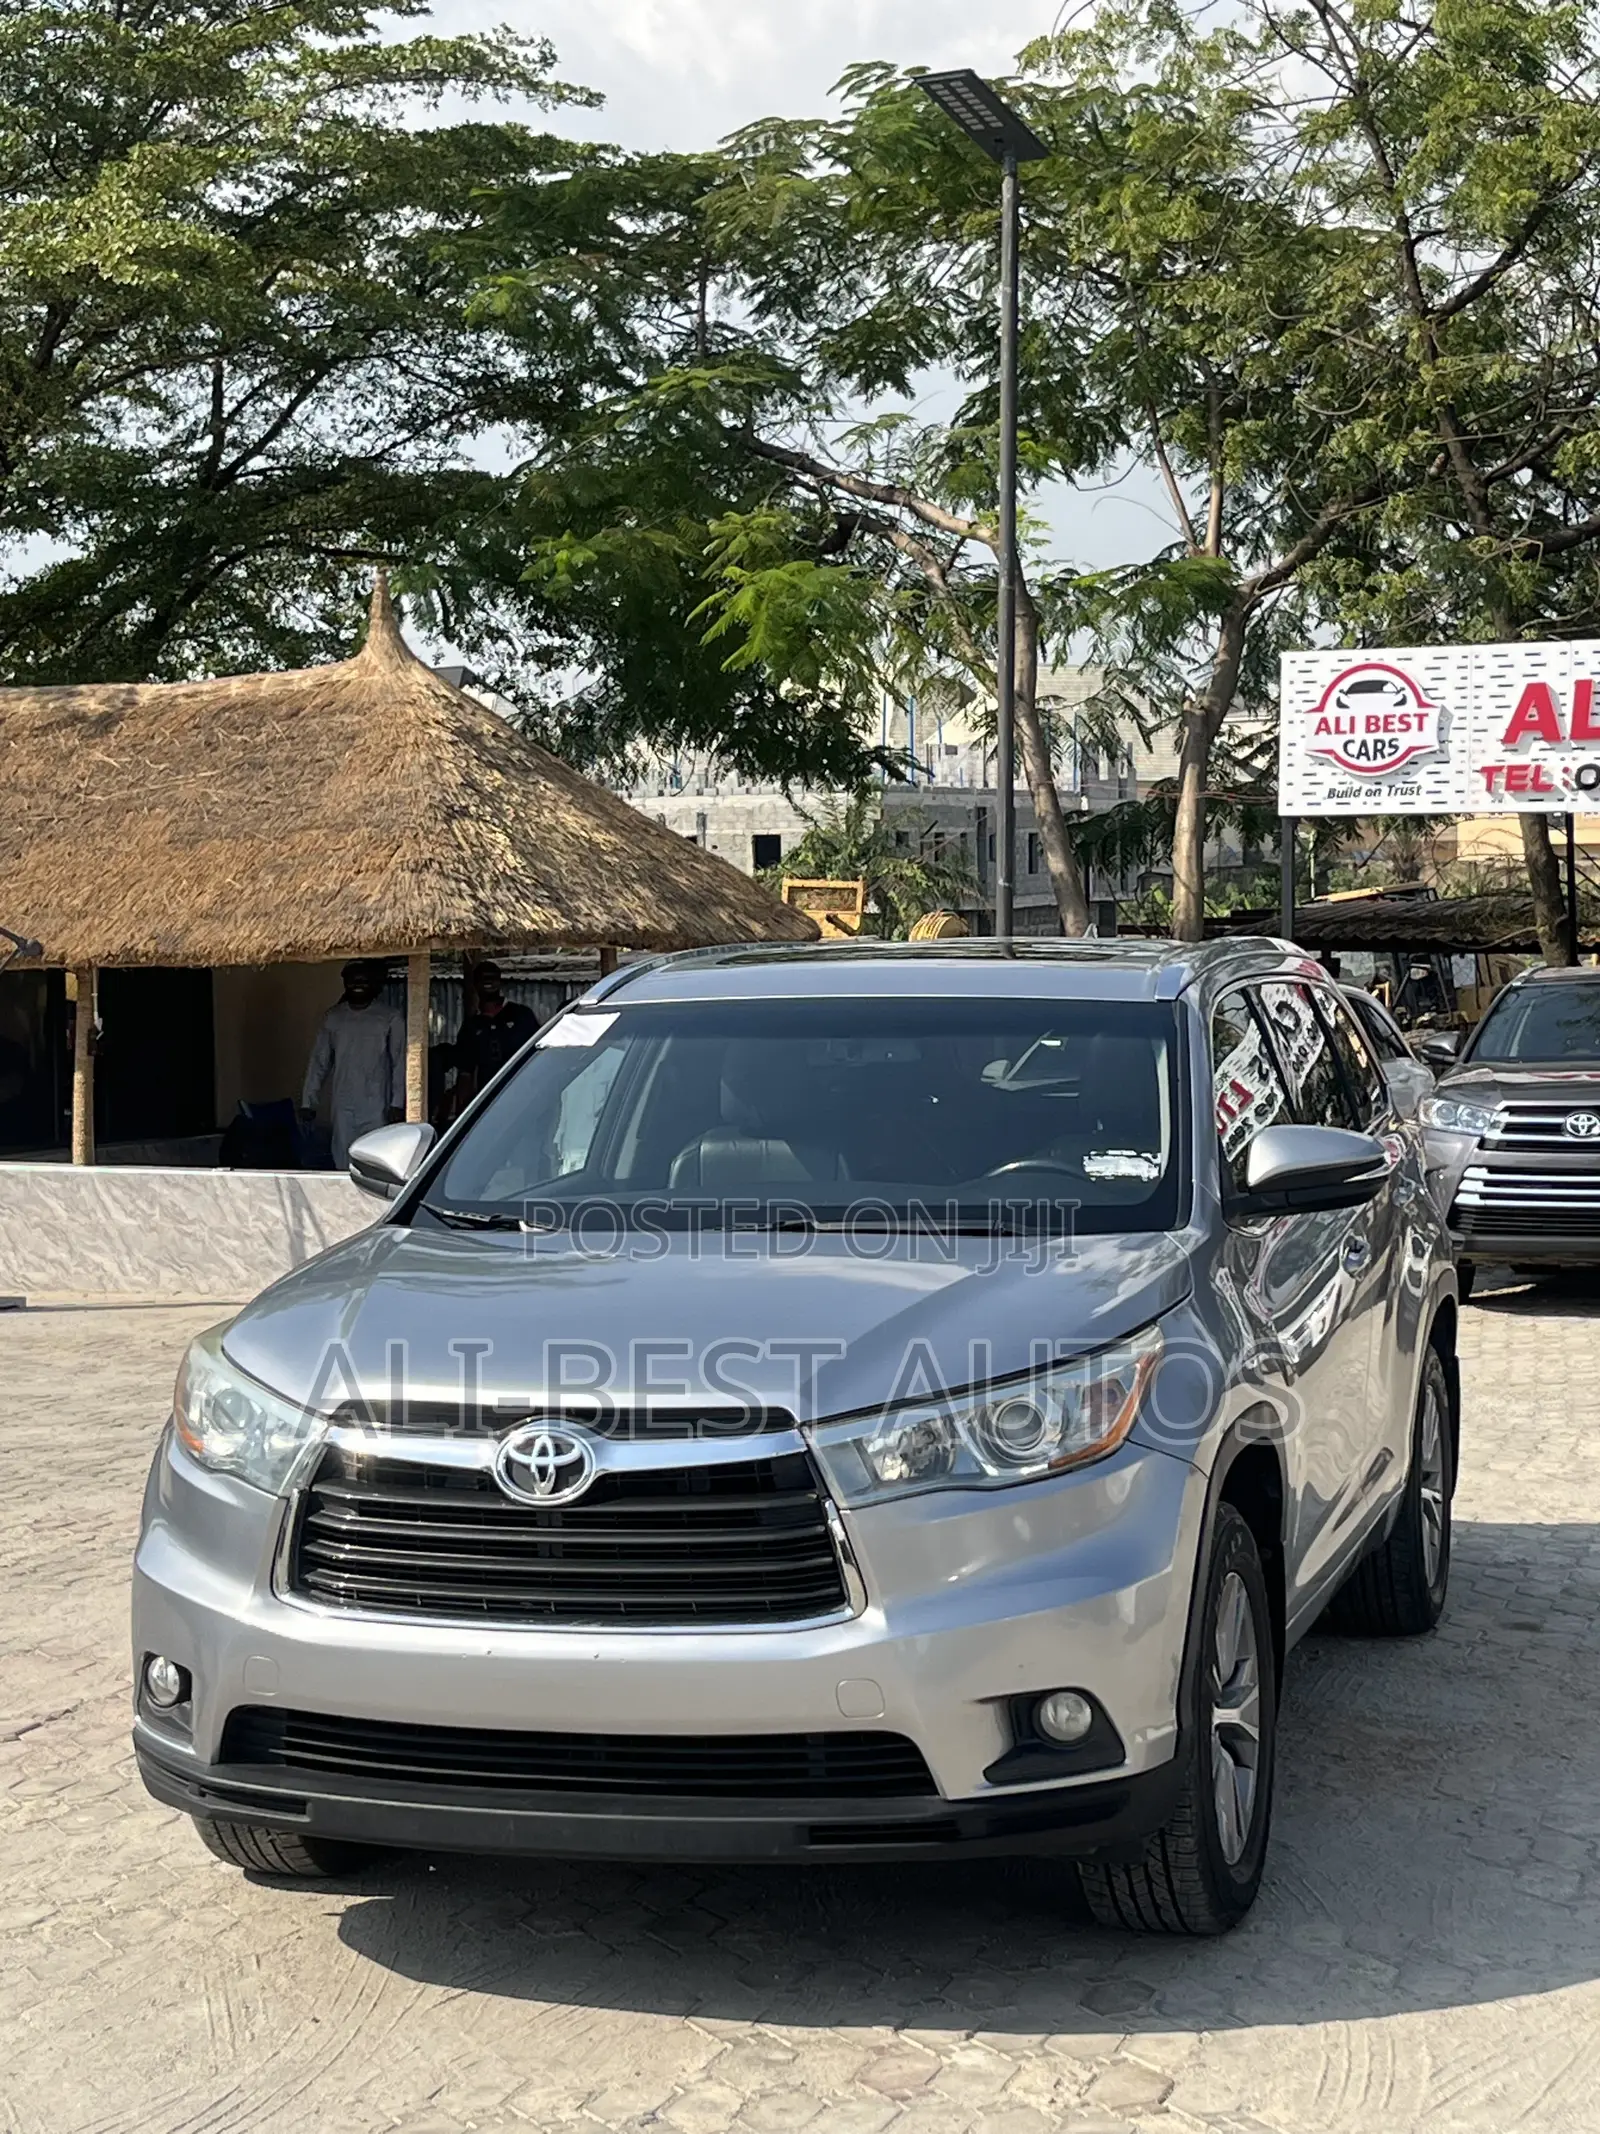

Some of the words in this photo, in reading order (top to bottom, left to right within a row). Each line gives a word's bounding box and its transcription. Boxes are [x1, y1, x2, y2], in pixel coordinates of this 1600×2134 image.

[1314, 715, 1356, 736] ALI
[1365, 712, 1429, 734] BEST
[1342, 737, 1400, 762] CARS
[1327, 786, 1363, 799] Build
[1364, 786, 1382, 798] on
[1387, 783, 1423, 797] Trust
